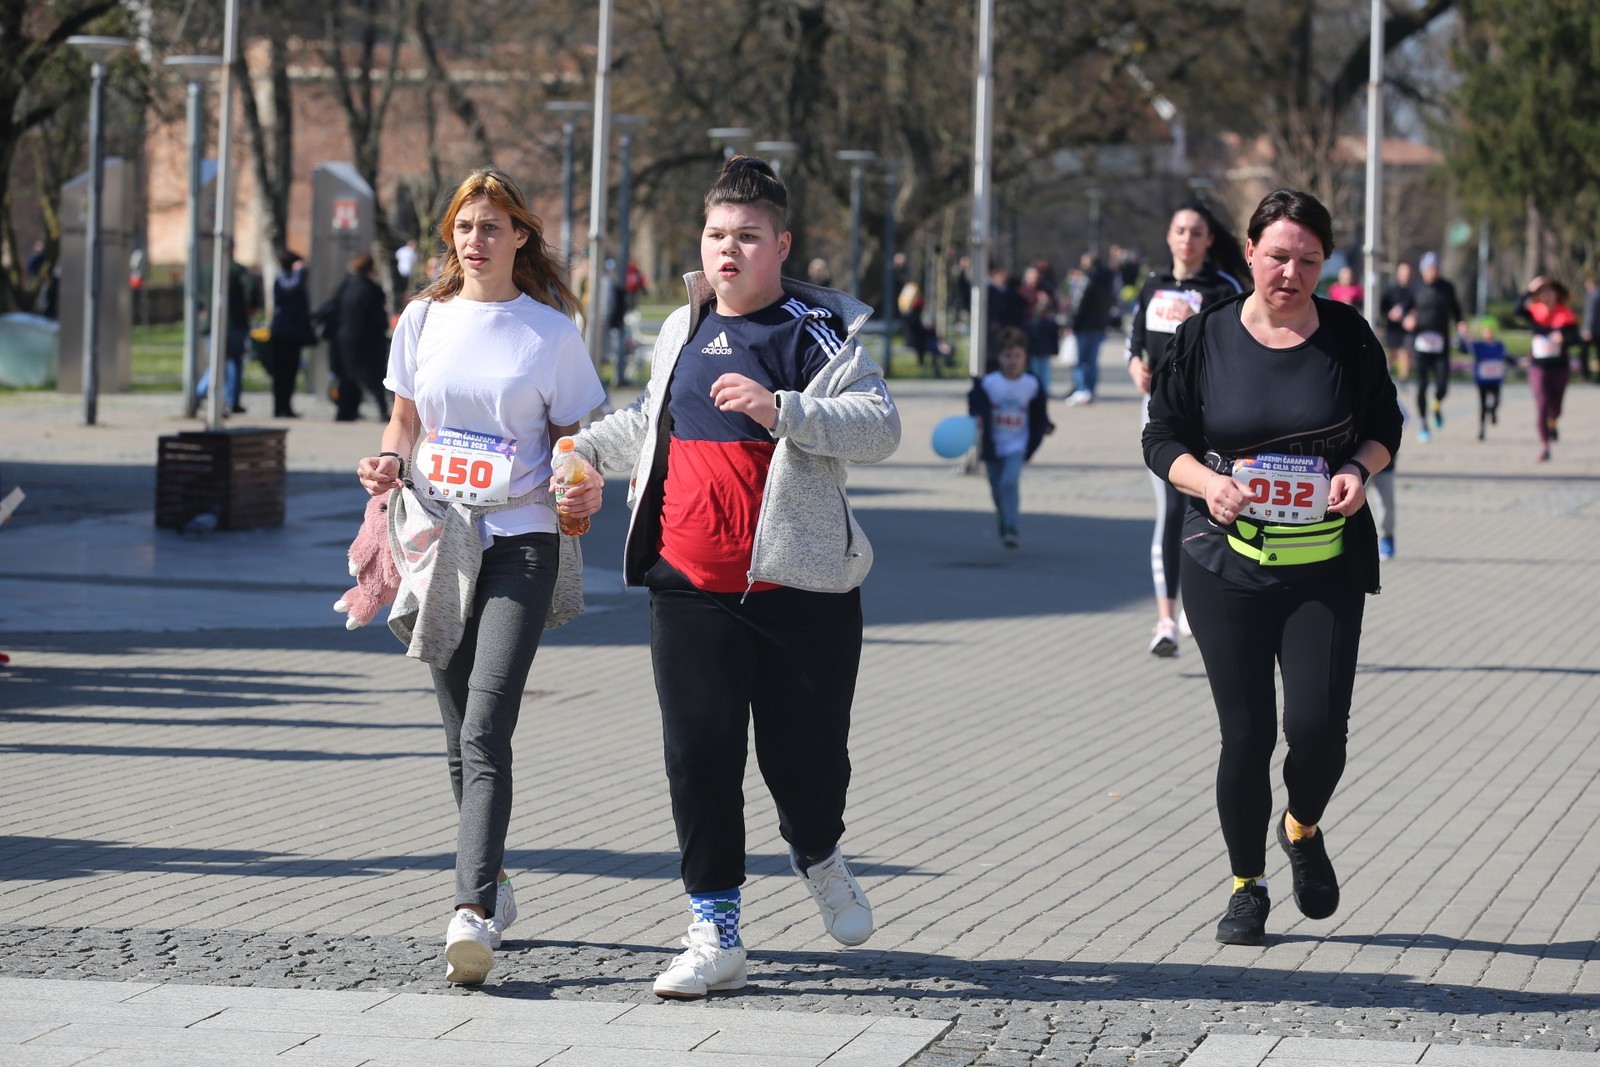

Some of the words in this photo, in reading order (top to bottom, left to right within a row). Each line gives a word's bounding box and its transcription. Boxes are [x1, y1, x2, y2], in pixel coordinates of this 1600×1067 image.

[701, 345, 732, 355] adidas
[428, 454, 493, 489] 150
[1249, 478, 1315, 508] 032
